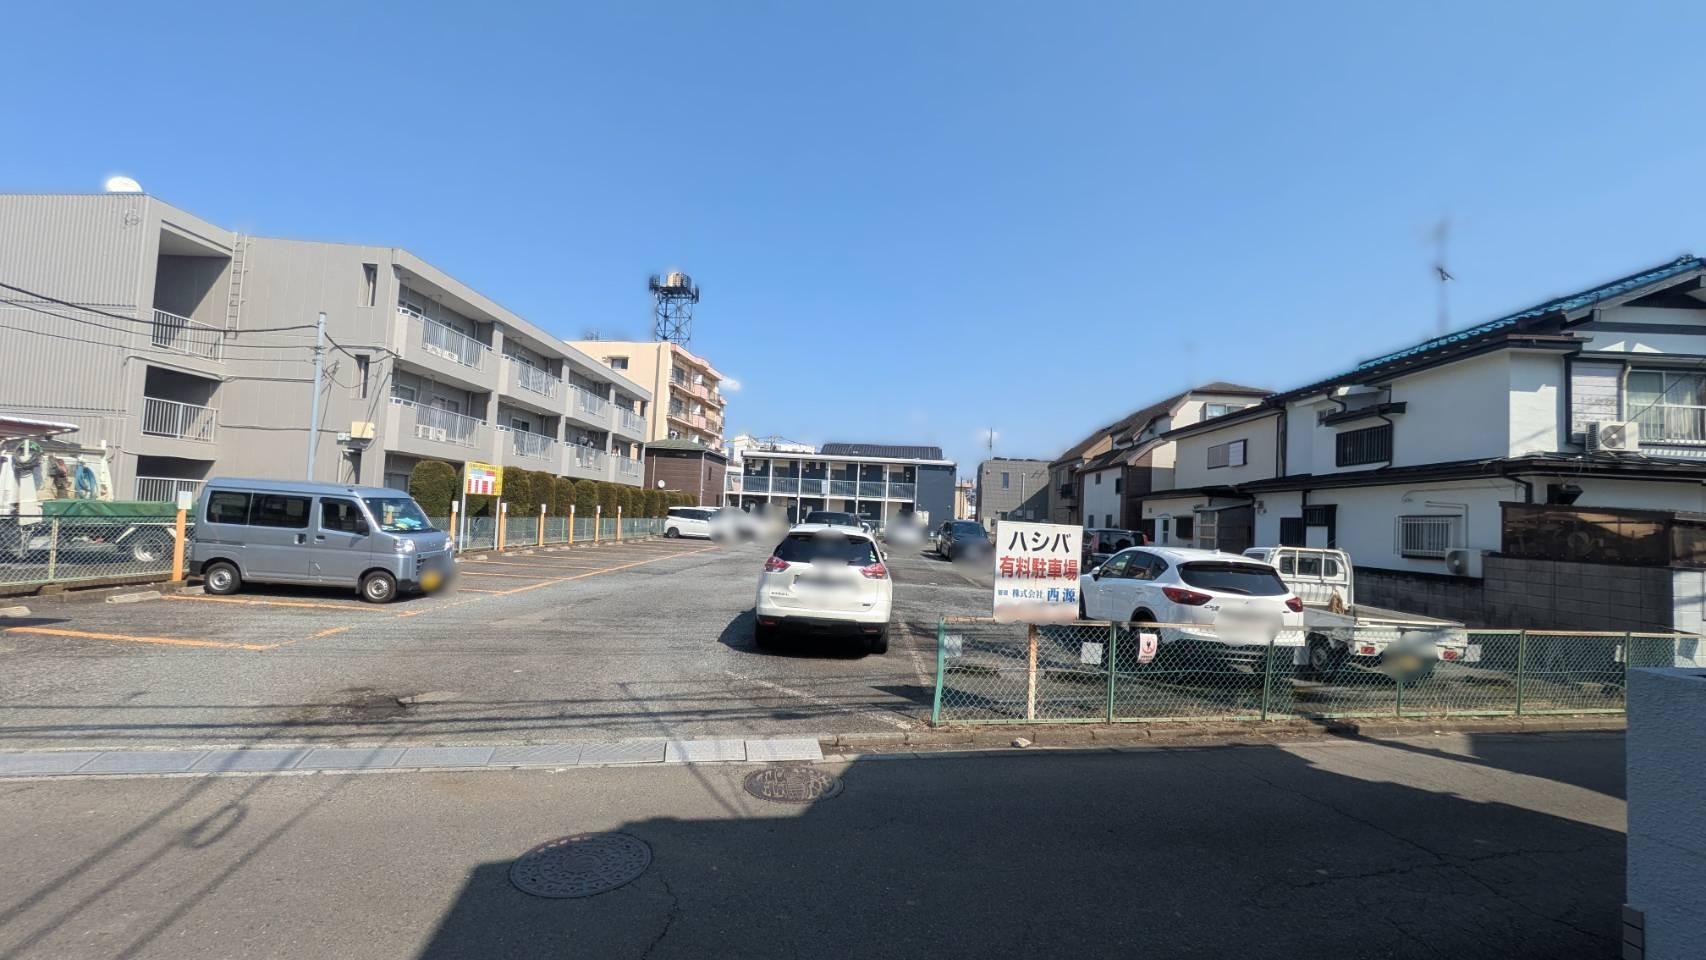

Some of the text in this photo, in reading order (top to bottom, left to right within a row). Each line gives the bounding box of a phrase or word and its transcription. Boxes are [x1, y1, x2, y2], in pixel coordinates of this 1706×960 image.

[1008, 531, 1072, 554] ハシバ
[999, 555, 1079, 582] 有料駐車場
